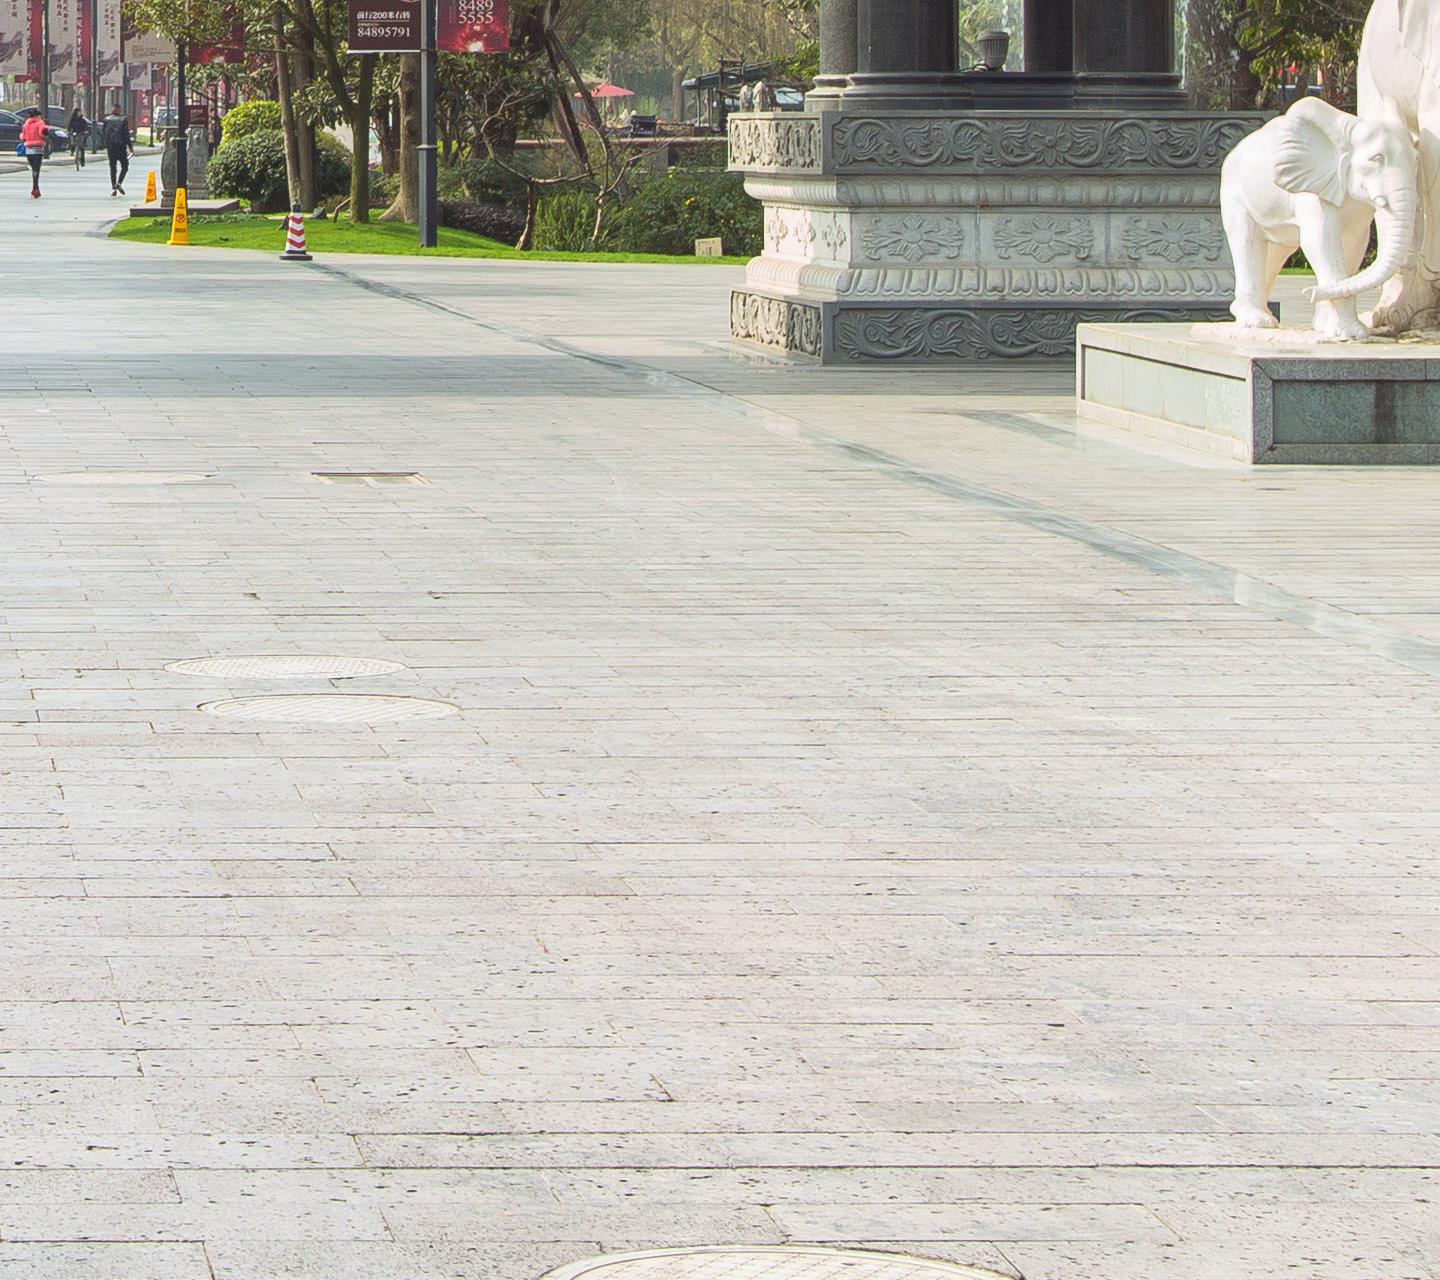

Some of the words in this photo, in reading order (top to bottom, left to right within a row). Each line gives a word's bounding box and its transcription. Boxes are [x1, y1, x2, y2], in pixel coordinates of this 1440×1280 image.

[458, 0, 494, 12] 8489
[458, 12, 494, 24] 5555
[358, 27, 410, 37] 84895791
